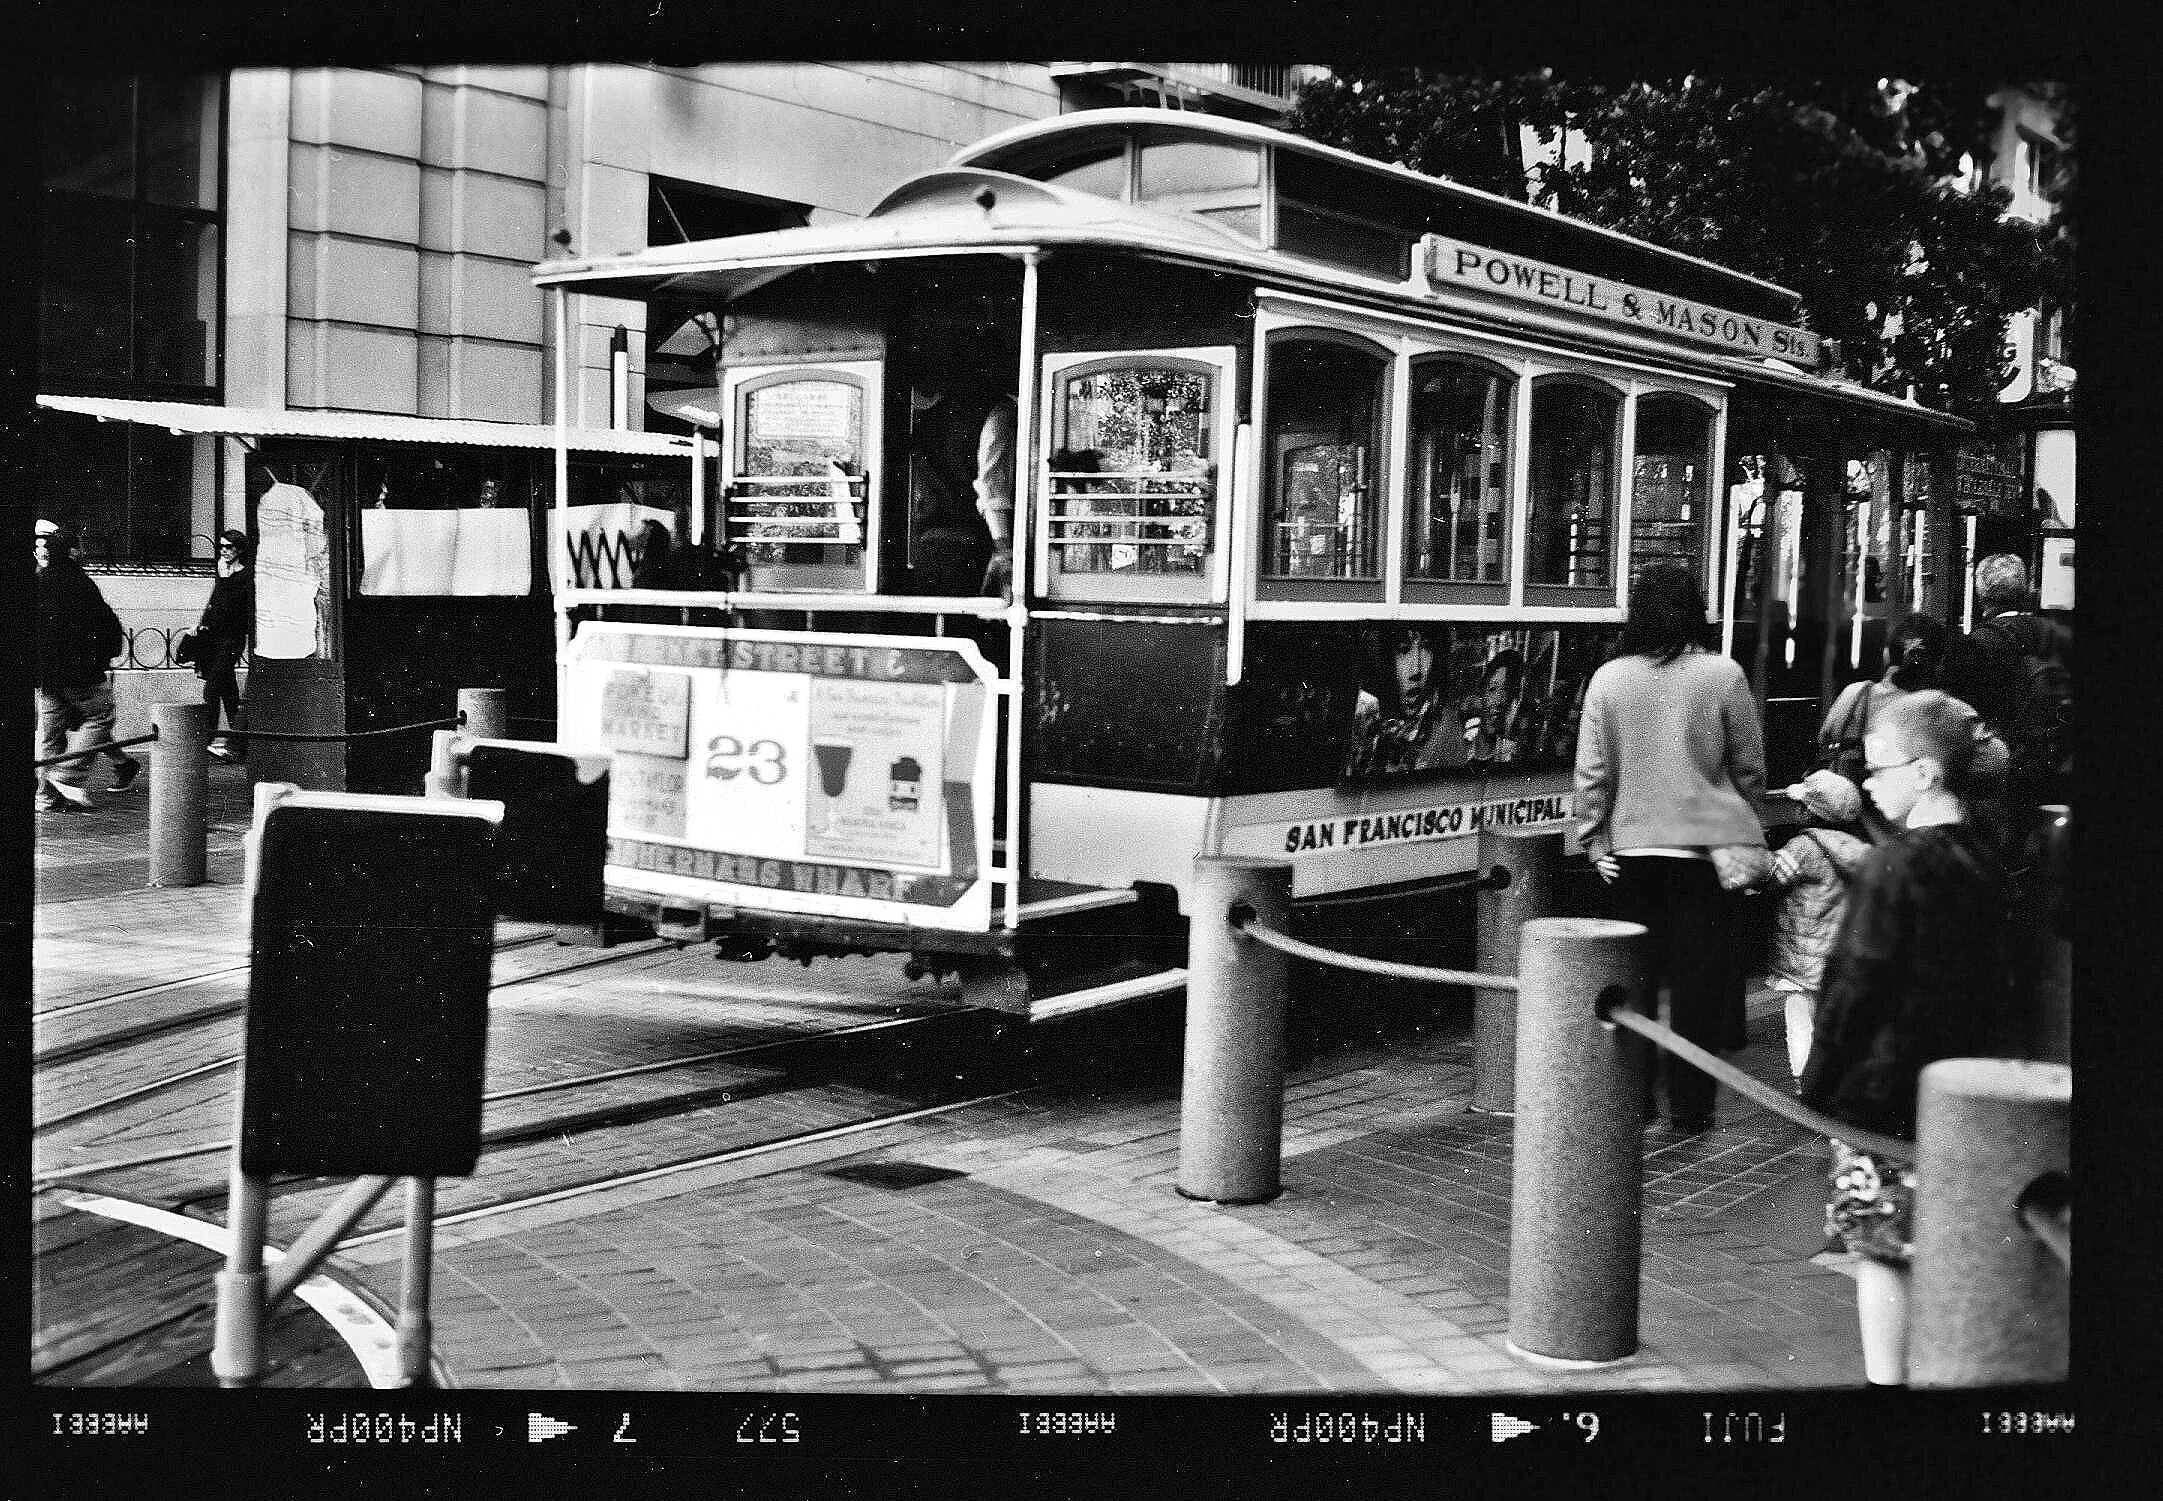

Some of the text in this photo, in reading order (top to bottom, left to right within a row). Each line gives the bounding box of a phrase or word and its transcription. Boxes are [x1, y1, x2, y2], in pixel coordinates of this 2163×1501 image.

[1453, 248, 1607, 311] POWELL
[1621, 292, 1643, 322] &
[1656, 299, 1760, 347] MASON
[736, 640, 866, 675] STREET
[705, 735, 788, 786] 23
[1285, 797, 1566, 853] SAN FRANCISCO MUNICIPAL
[307, 1412, 461, 1444] NP400PR
[613, 1412, 638, 1444] 7
[736, 1412, 801, 1444] 577
[1270, 1412, 1426, 1444] NP400PR
[1703, 1411, 1786, 1444] FUJI
